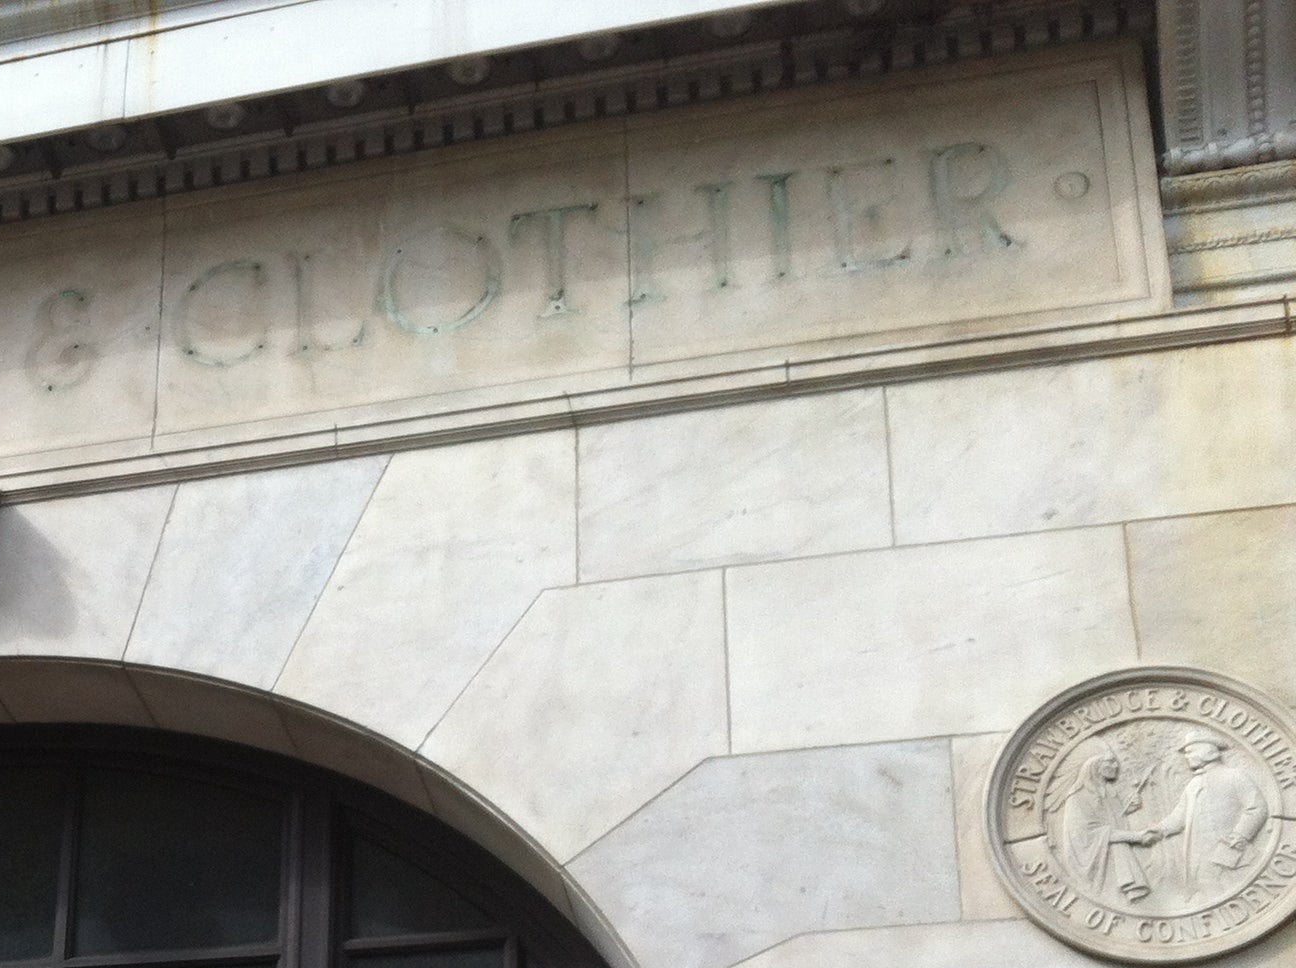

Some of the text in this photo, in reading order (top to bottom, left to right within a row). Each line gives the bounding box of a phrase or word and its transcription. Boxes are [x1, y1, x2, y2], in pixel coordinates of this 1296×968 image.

[25, 285, 97, 395] &
[174, 141, 1025, 369] CLOTHIER
[1170, 689, 1190, 712] &
[1021, 858, 1079, 918] SEAL
[1084, 910, 1125, 936] OF
